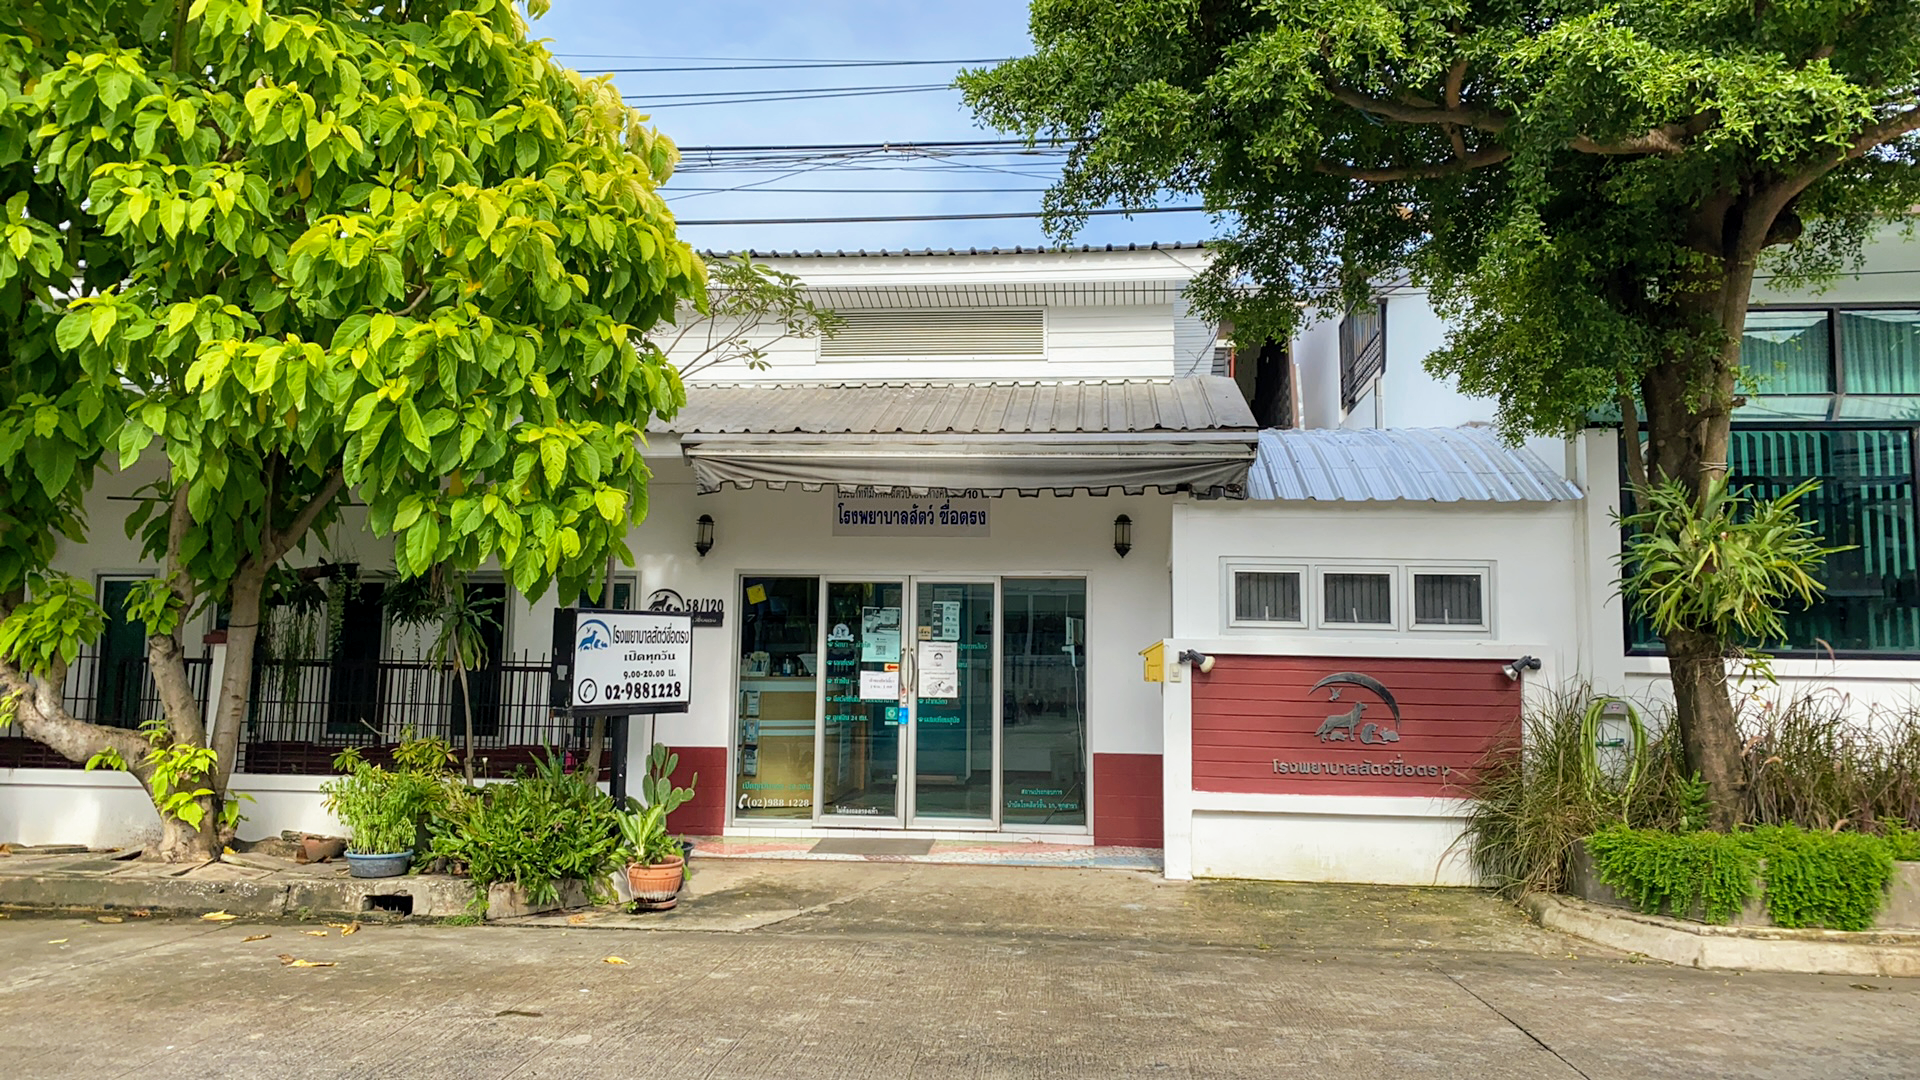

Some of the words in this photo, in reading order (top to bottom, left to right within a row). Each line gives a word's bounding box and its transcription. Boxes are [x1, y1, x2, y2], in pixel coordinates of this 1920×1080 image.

[838, 503, 935, 525] โรงพยาบาลสัตว์
[685, 598, 724, 613] 58/120
[624, 650, 676, 664] เปิดทุกวัน
[623, 670, 665, 680] 9.00-20.00
[605, 681, 681, 701] 02-9881228
[788, 799, 810, 807] 1228
